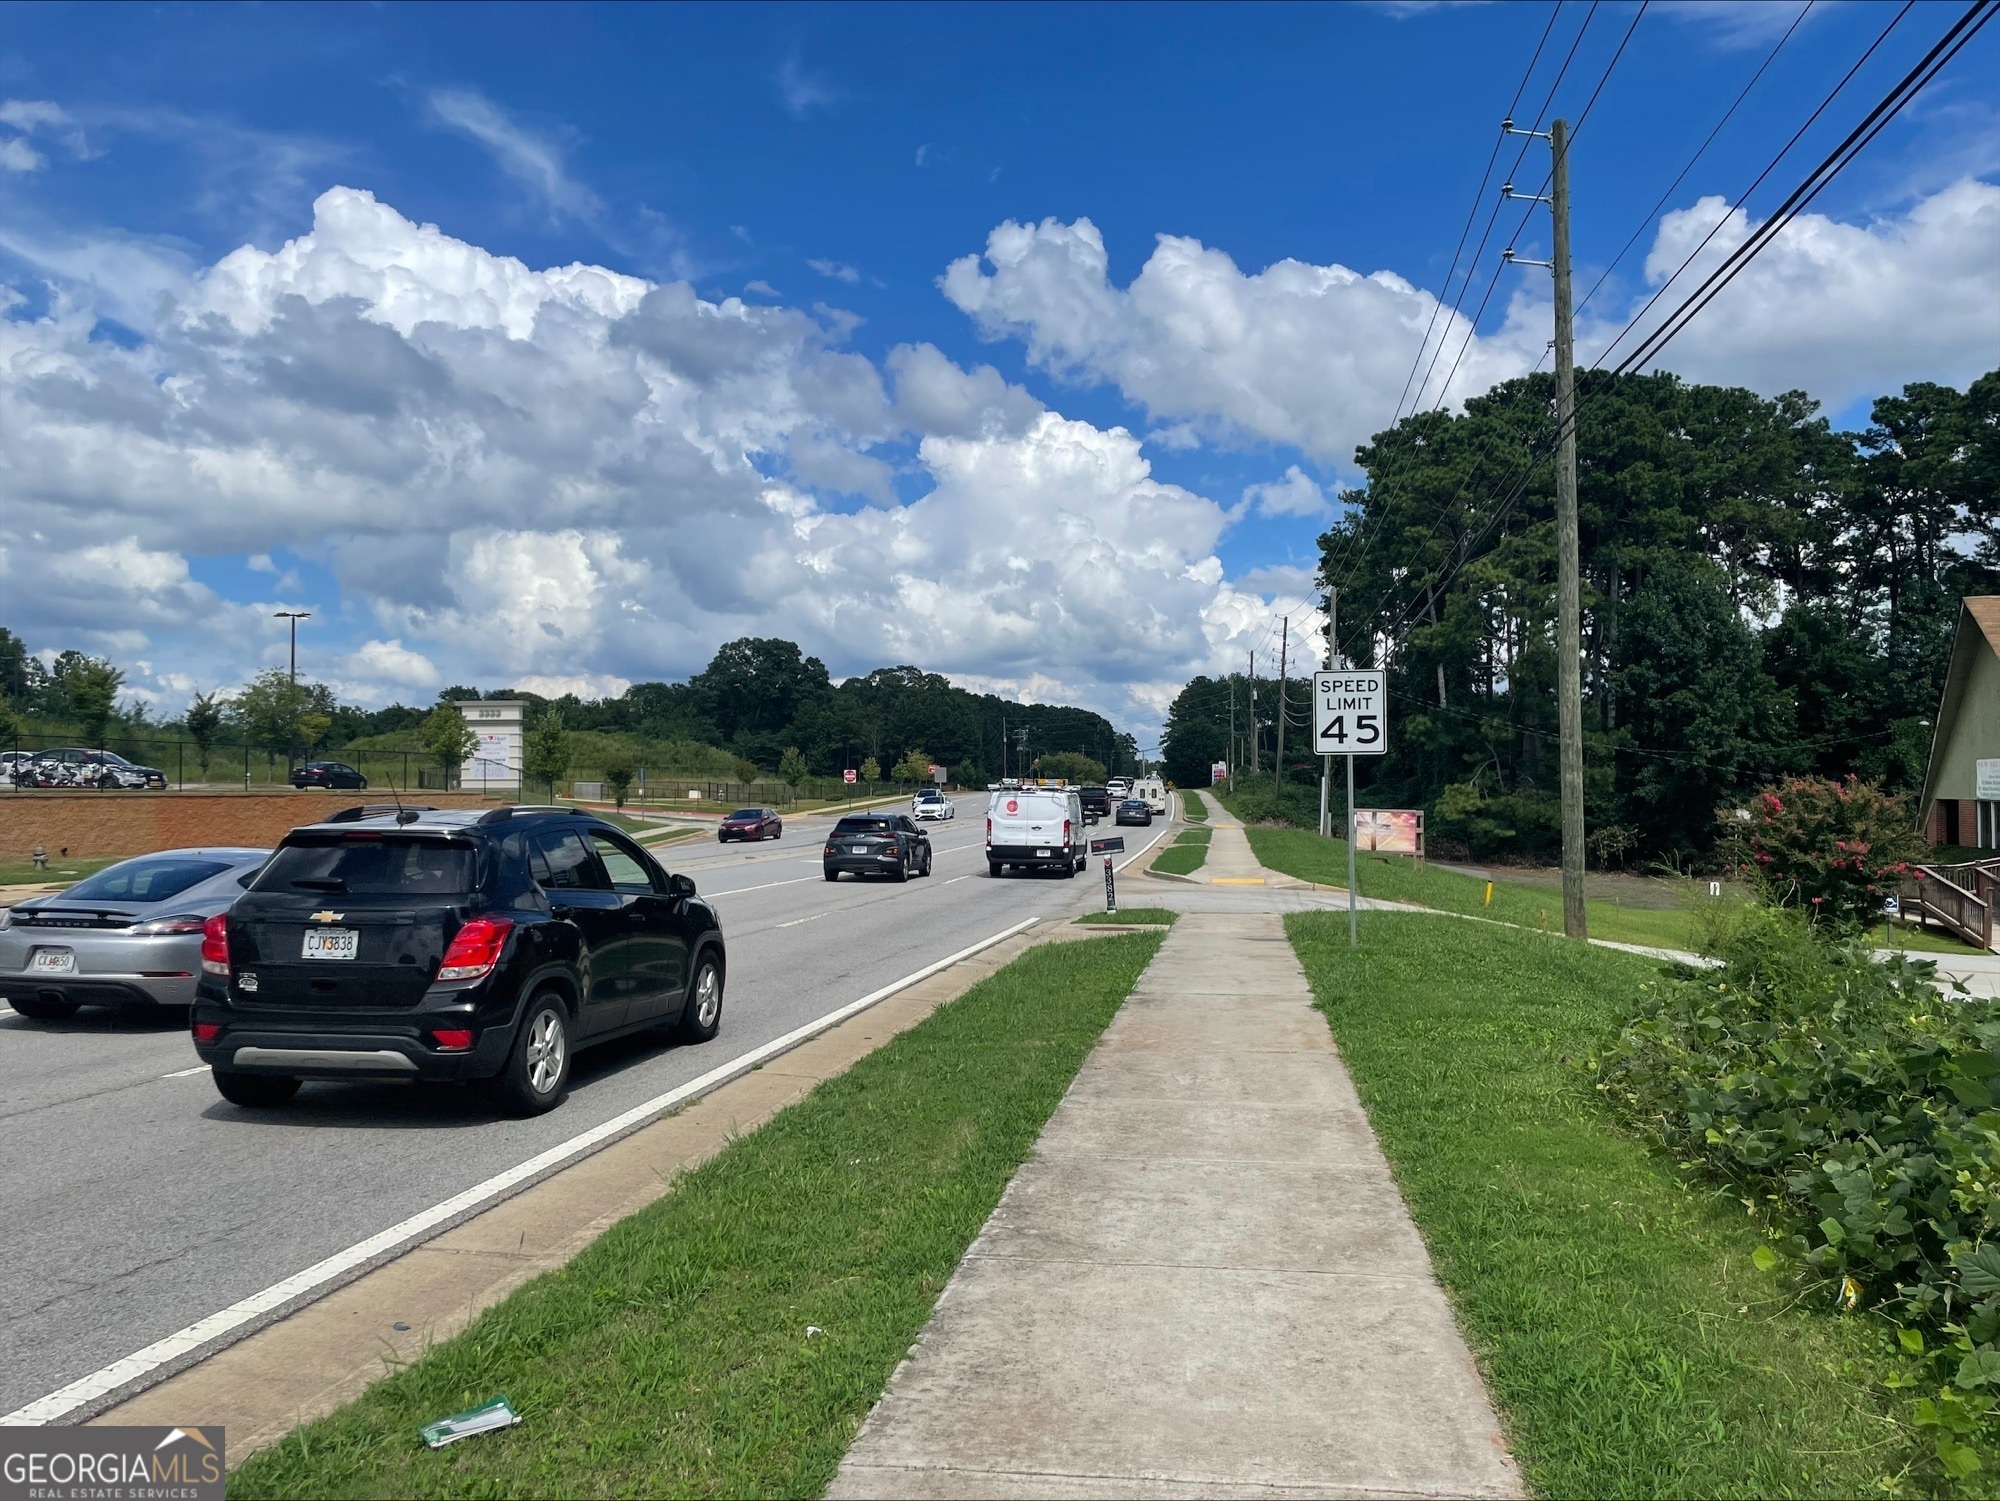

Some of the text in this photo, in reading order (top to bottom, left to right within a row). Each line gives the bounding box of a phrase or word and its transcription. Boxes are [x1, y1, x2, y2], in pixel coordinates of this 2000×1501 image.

[1320, 679, 1379, 693] SPEED
[1327, 697, 1372, 710] LIMIT
[478, 709, 502, 718] 3333
[1320, 715, 1380, 744] 45
[1105, 869, 1114, 901] 3382
[308, 936, 353, 951] CJY3838
